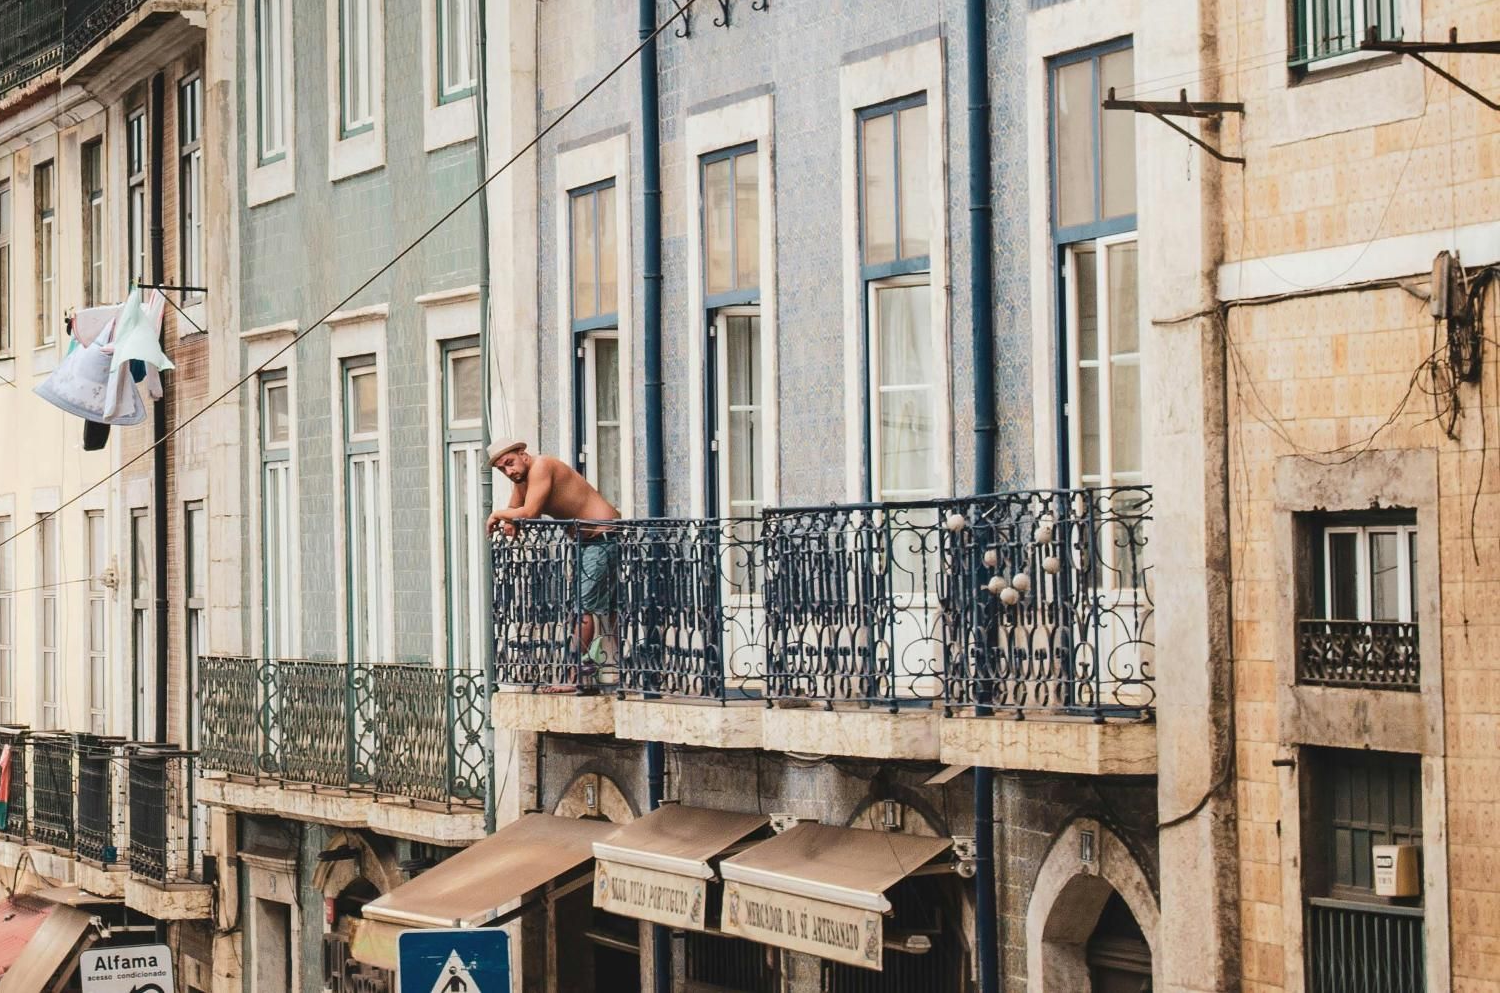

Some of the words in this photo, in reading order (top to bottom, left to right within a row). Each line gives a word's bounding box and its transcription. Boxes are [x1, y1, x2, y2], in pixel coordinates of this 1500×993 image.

[744, 900, 784, 933] MERCADOR
[787, 910, 797, 937] DA
[812, 915, 859, 951] ARTESANATO
[94, 955, 158, 971] Alfama
[87, 974, 112, 982] acesso
[117, 970, 167, 980] condicionado
